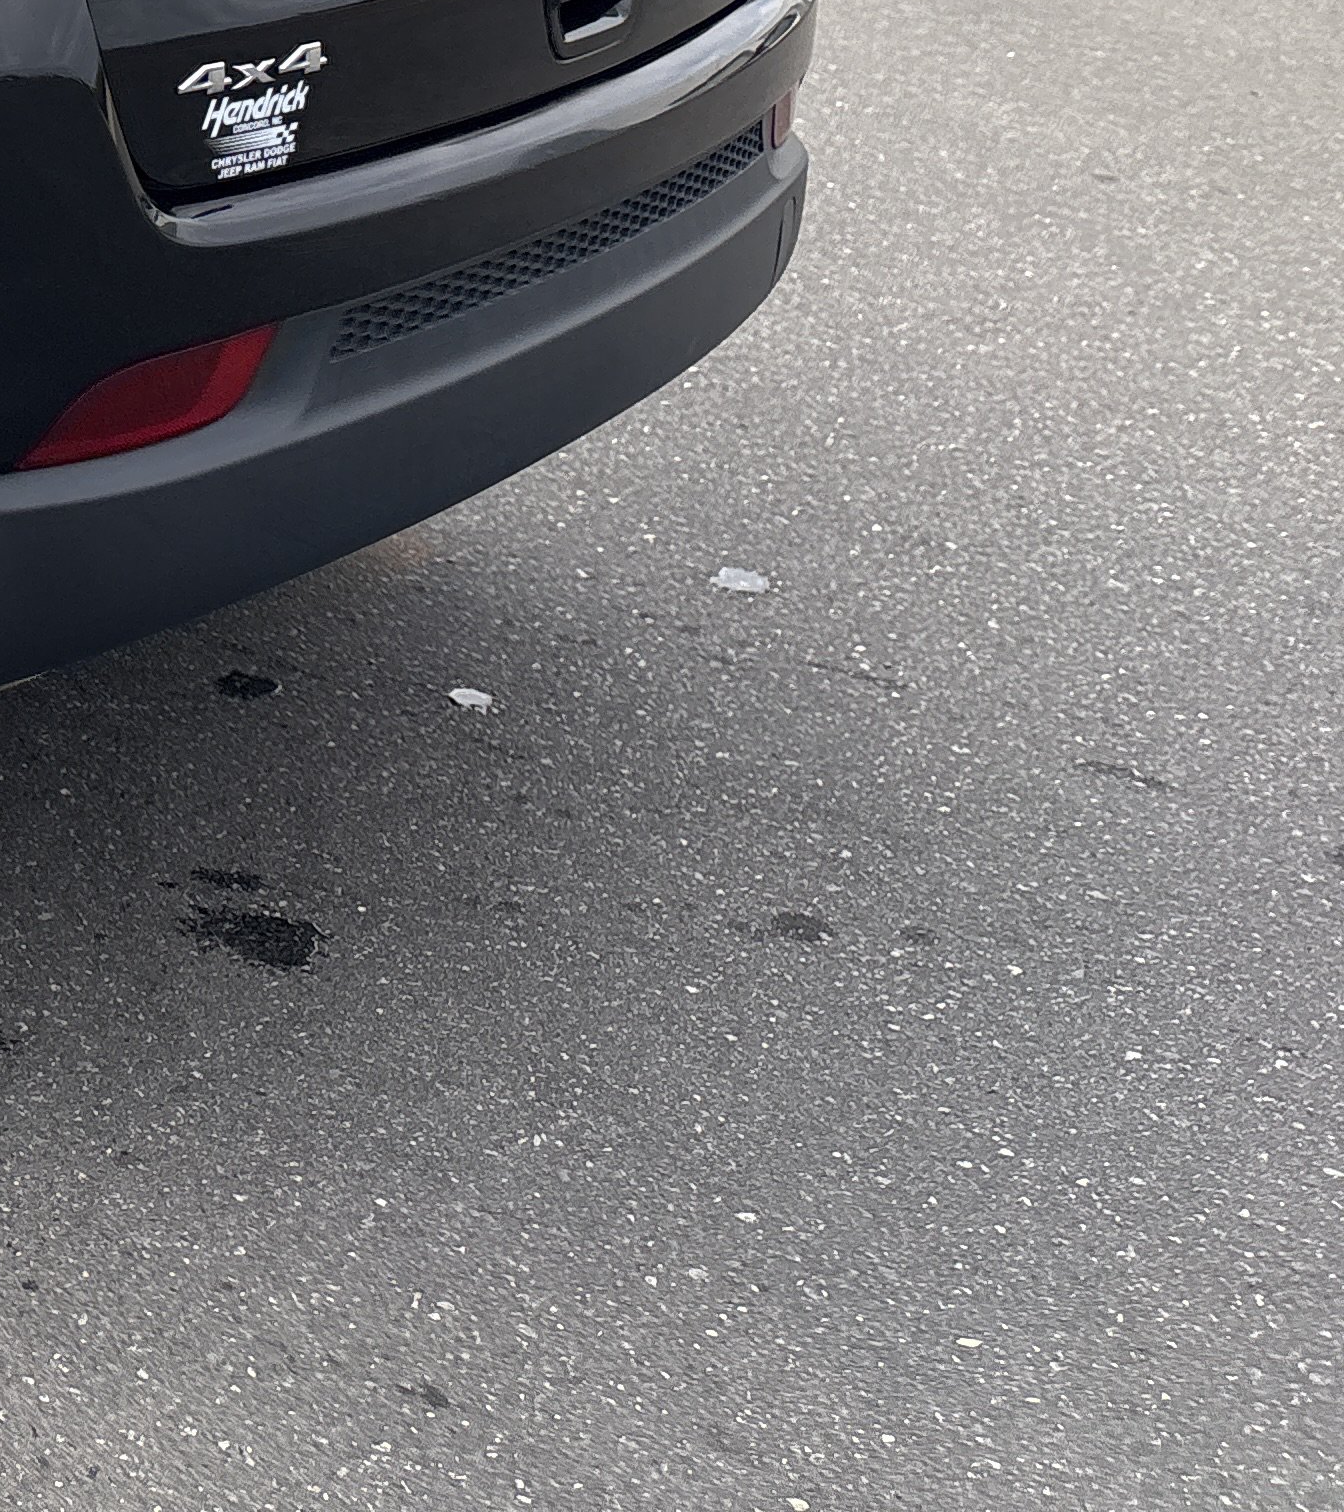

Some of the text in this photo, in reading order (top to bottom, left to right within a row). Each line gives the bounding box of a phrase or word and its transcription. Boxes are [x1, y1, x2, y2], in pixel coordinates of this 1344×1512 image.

[177, 40, 328, 95] 4x4
[201, 79, 310, 138] Hendrick
[211, 141, 297, 170] CHRYSLER DODGE
[217, 154, 289, 180] JEEP RAM FIAT
